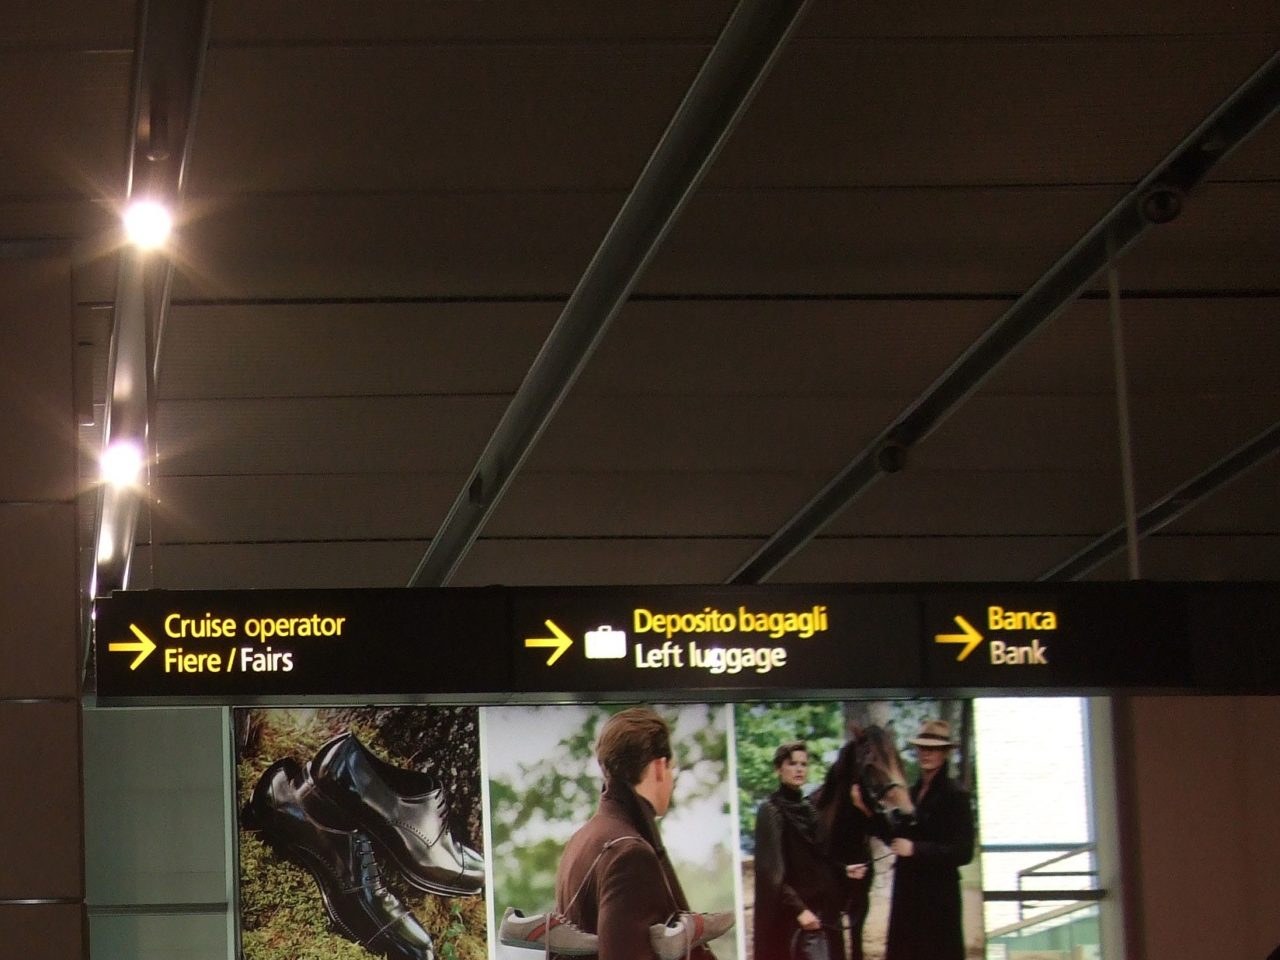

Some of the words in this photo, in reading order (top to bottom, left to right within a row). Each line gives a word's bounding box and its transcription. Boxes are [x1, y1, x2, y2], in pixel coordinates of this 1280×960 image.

[165, 613, 236, 638] Cruise
[245, 614, 346, 643] operator
[633, 607, 736, 638] Deposito
[739, 605, 828, 637] bagagli
[988, 606, 1057, 631] Banca
[165, 648, 222, 673] Fiere
[241, 646, 294, 672] Fairs
[635, 642, 683, 669] Left
[689, 642, 787, 673] luggage
[990, 638, 1047, 665] Bank
